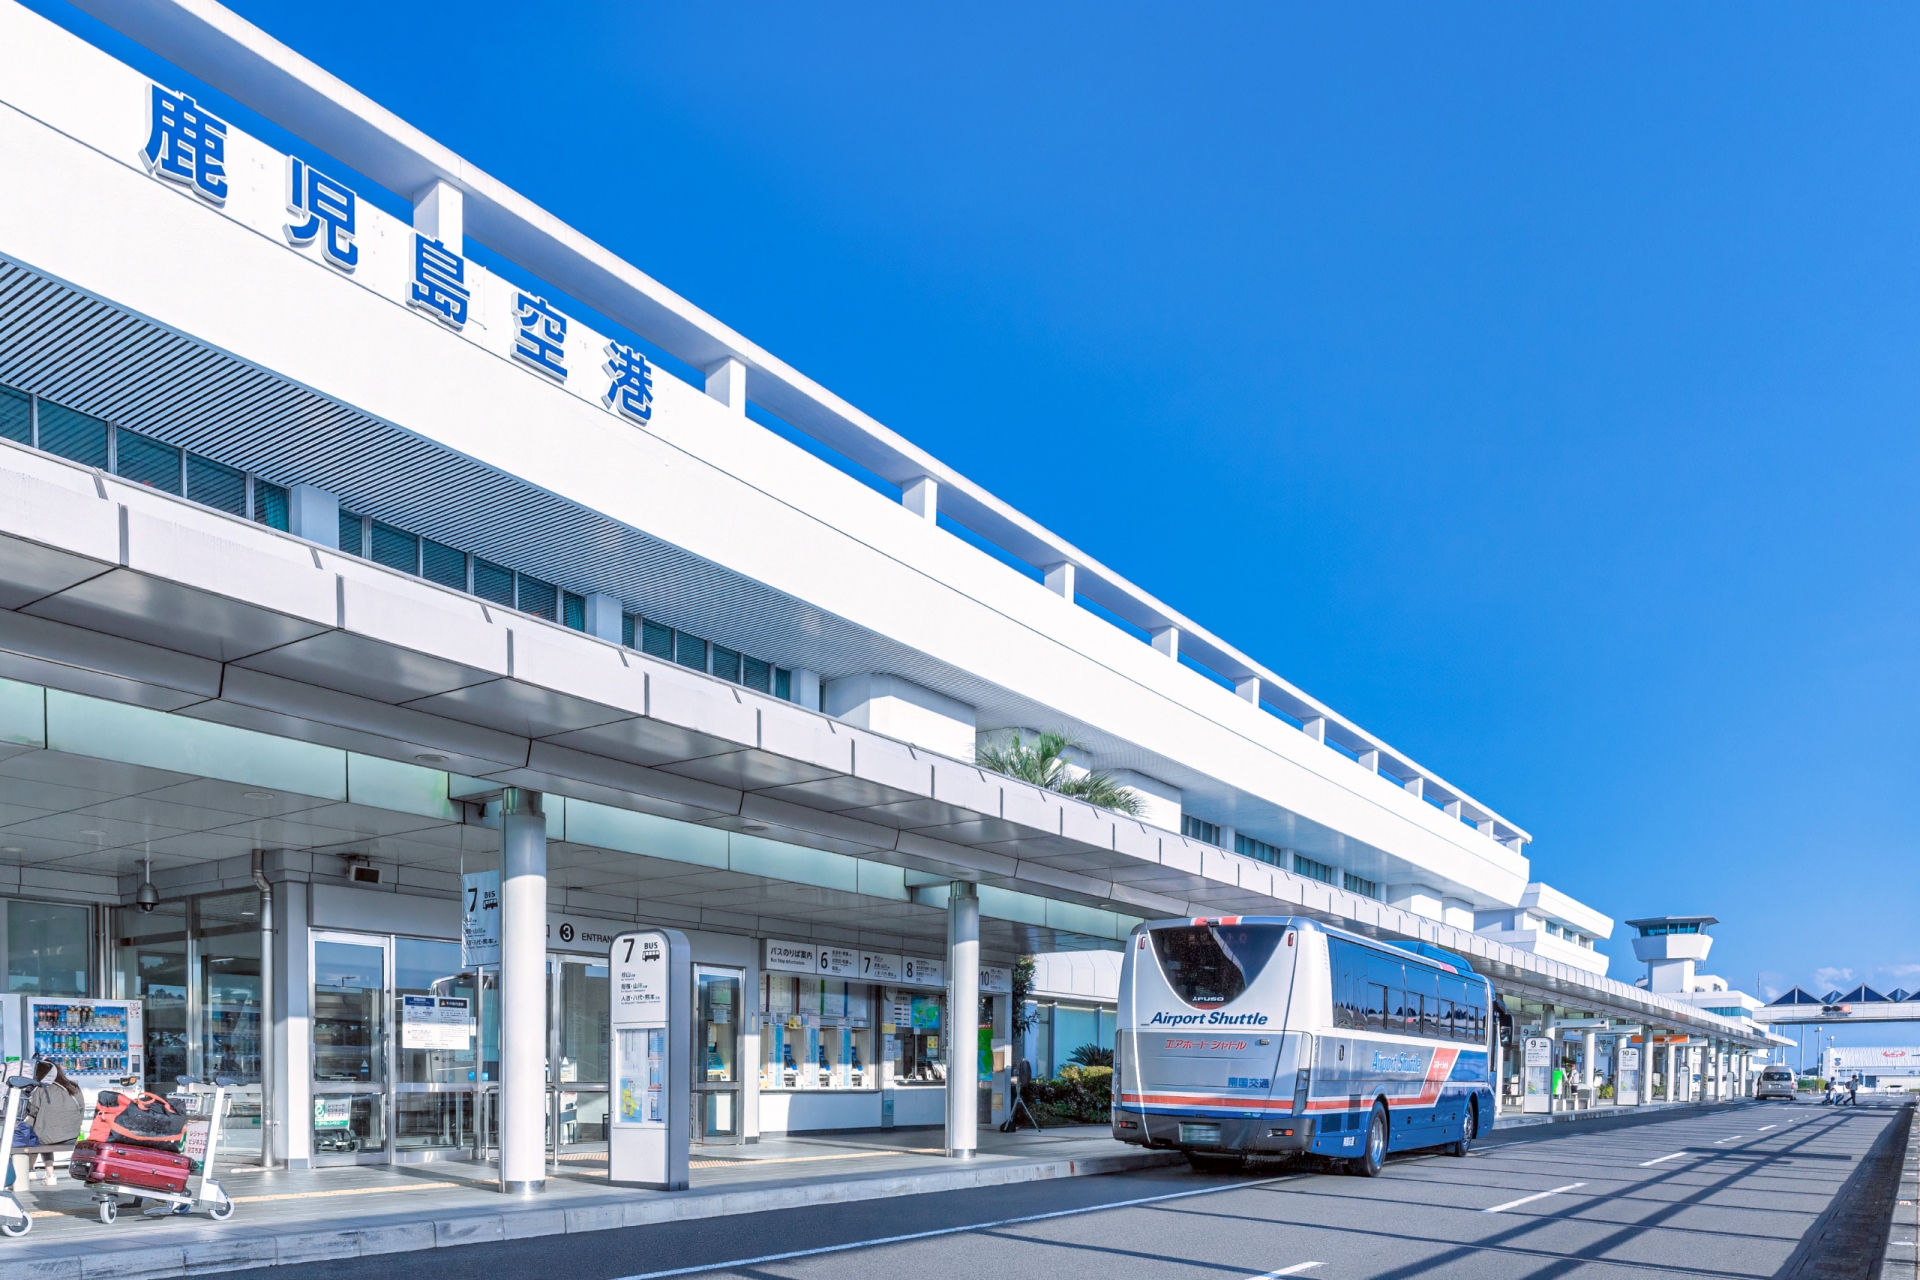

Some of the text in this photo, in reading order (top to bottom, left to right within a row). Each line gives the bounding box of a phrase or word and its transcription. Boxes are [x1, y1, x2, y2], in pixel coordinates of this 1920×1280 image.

[139, 82, 653, 425] 鹿児島空港
[468, 887, 478, 912] 7
[561, 924, 573, 941] 3
[623, 938, 658, 963] 7 BUS
[770, 947, 813, 960] バスのりば案内
[821, 952, 828, 969] 6
[864, 957, 871, 973] 7
[907, 962, 913, 978] 8
[980, 971, 990, 986] 10
[1151, 1011, 1268, 1027] Airport Shuttle
[1210, 1041, 1247, 1050] シャトル
[1530, 1040, 1537, 1048] 9
[1371, 1050, 1421, 1073] Airport Shuttle
[1227, 1077, 1270, 1089] 南国交通
